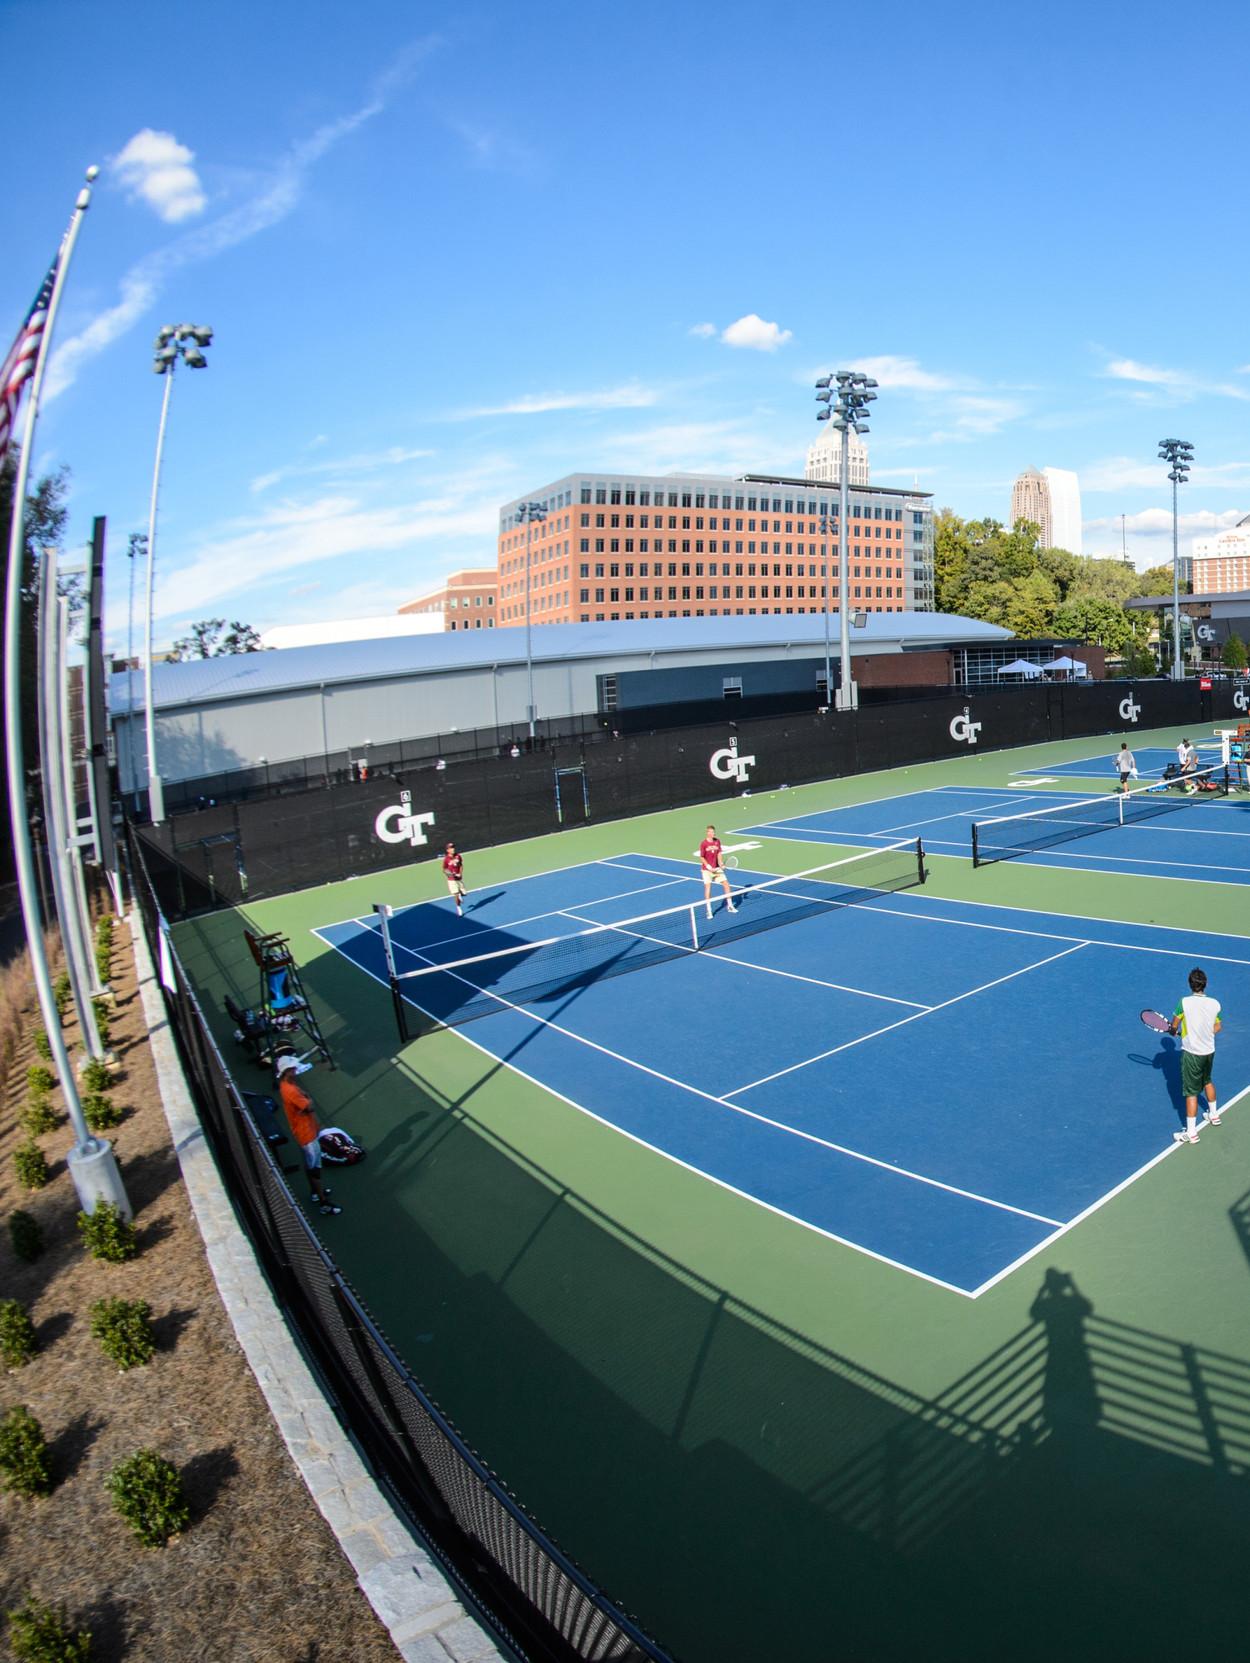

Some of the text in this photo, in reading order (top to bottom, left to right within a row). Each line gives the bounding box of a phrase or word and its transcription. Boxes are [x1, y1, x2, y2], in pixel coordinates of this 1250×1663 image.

[1198, 625, 1215, 641] GT
[1119, 699, 1141, 722] GT
[1233, 691, 1249, 711] GT
[950, 715, 982, 744] GT
[710, 747, 756, 782] GT
[375, 803, 435, 846] GT
